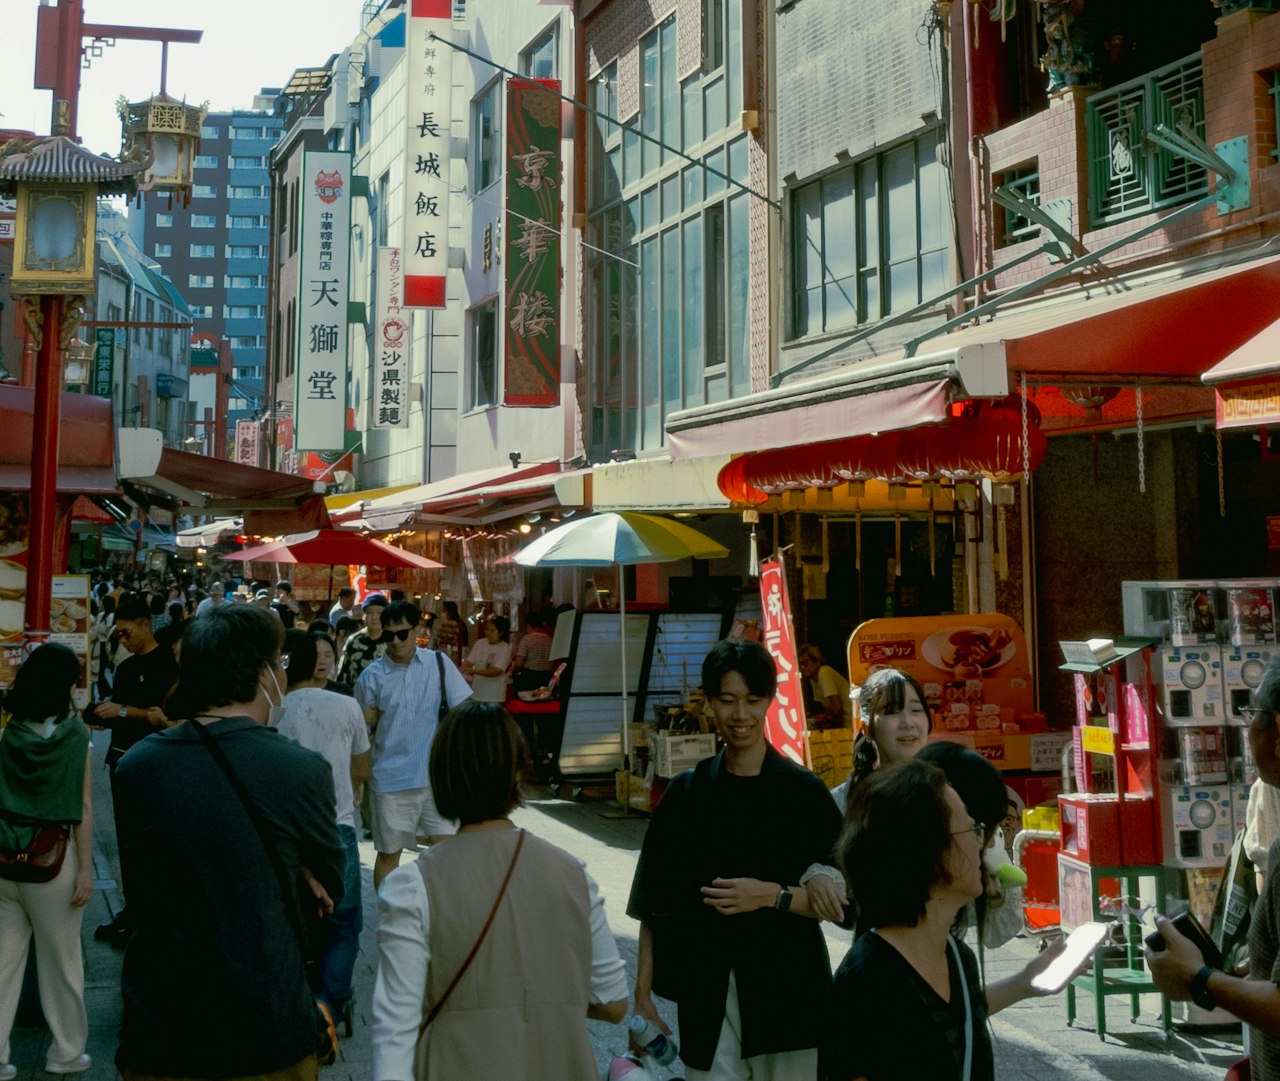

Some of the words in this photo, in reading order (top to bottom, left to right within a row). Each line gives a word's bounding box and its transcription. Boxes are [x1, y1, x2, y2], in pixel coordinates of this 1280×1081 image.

[414, 111, 442, 259] 長城飯店
[509, 145, 557, 339] 京華楼
[307, 278, 340, 401] 天獅堂
